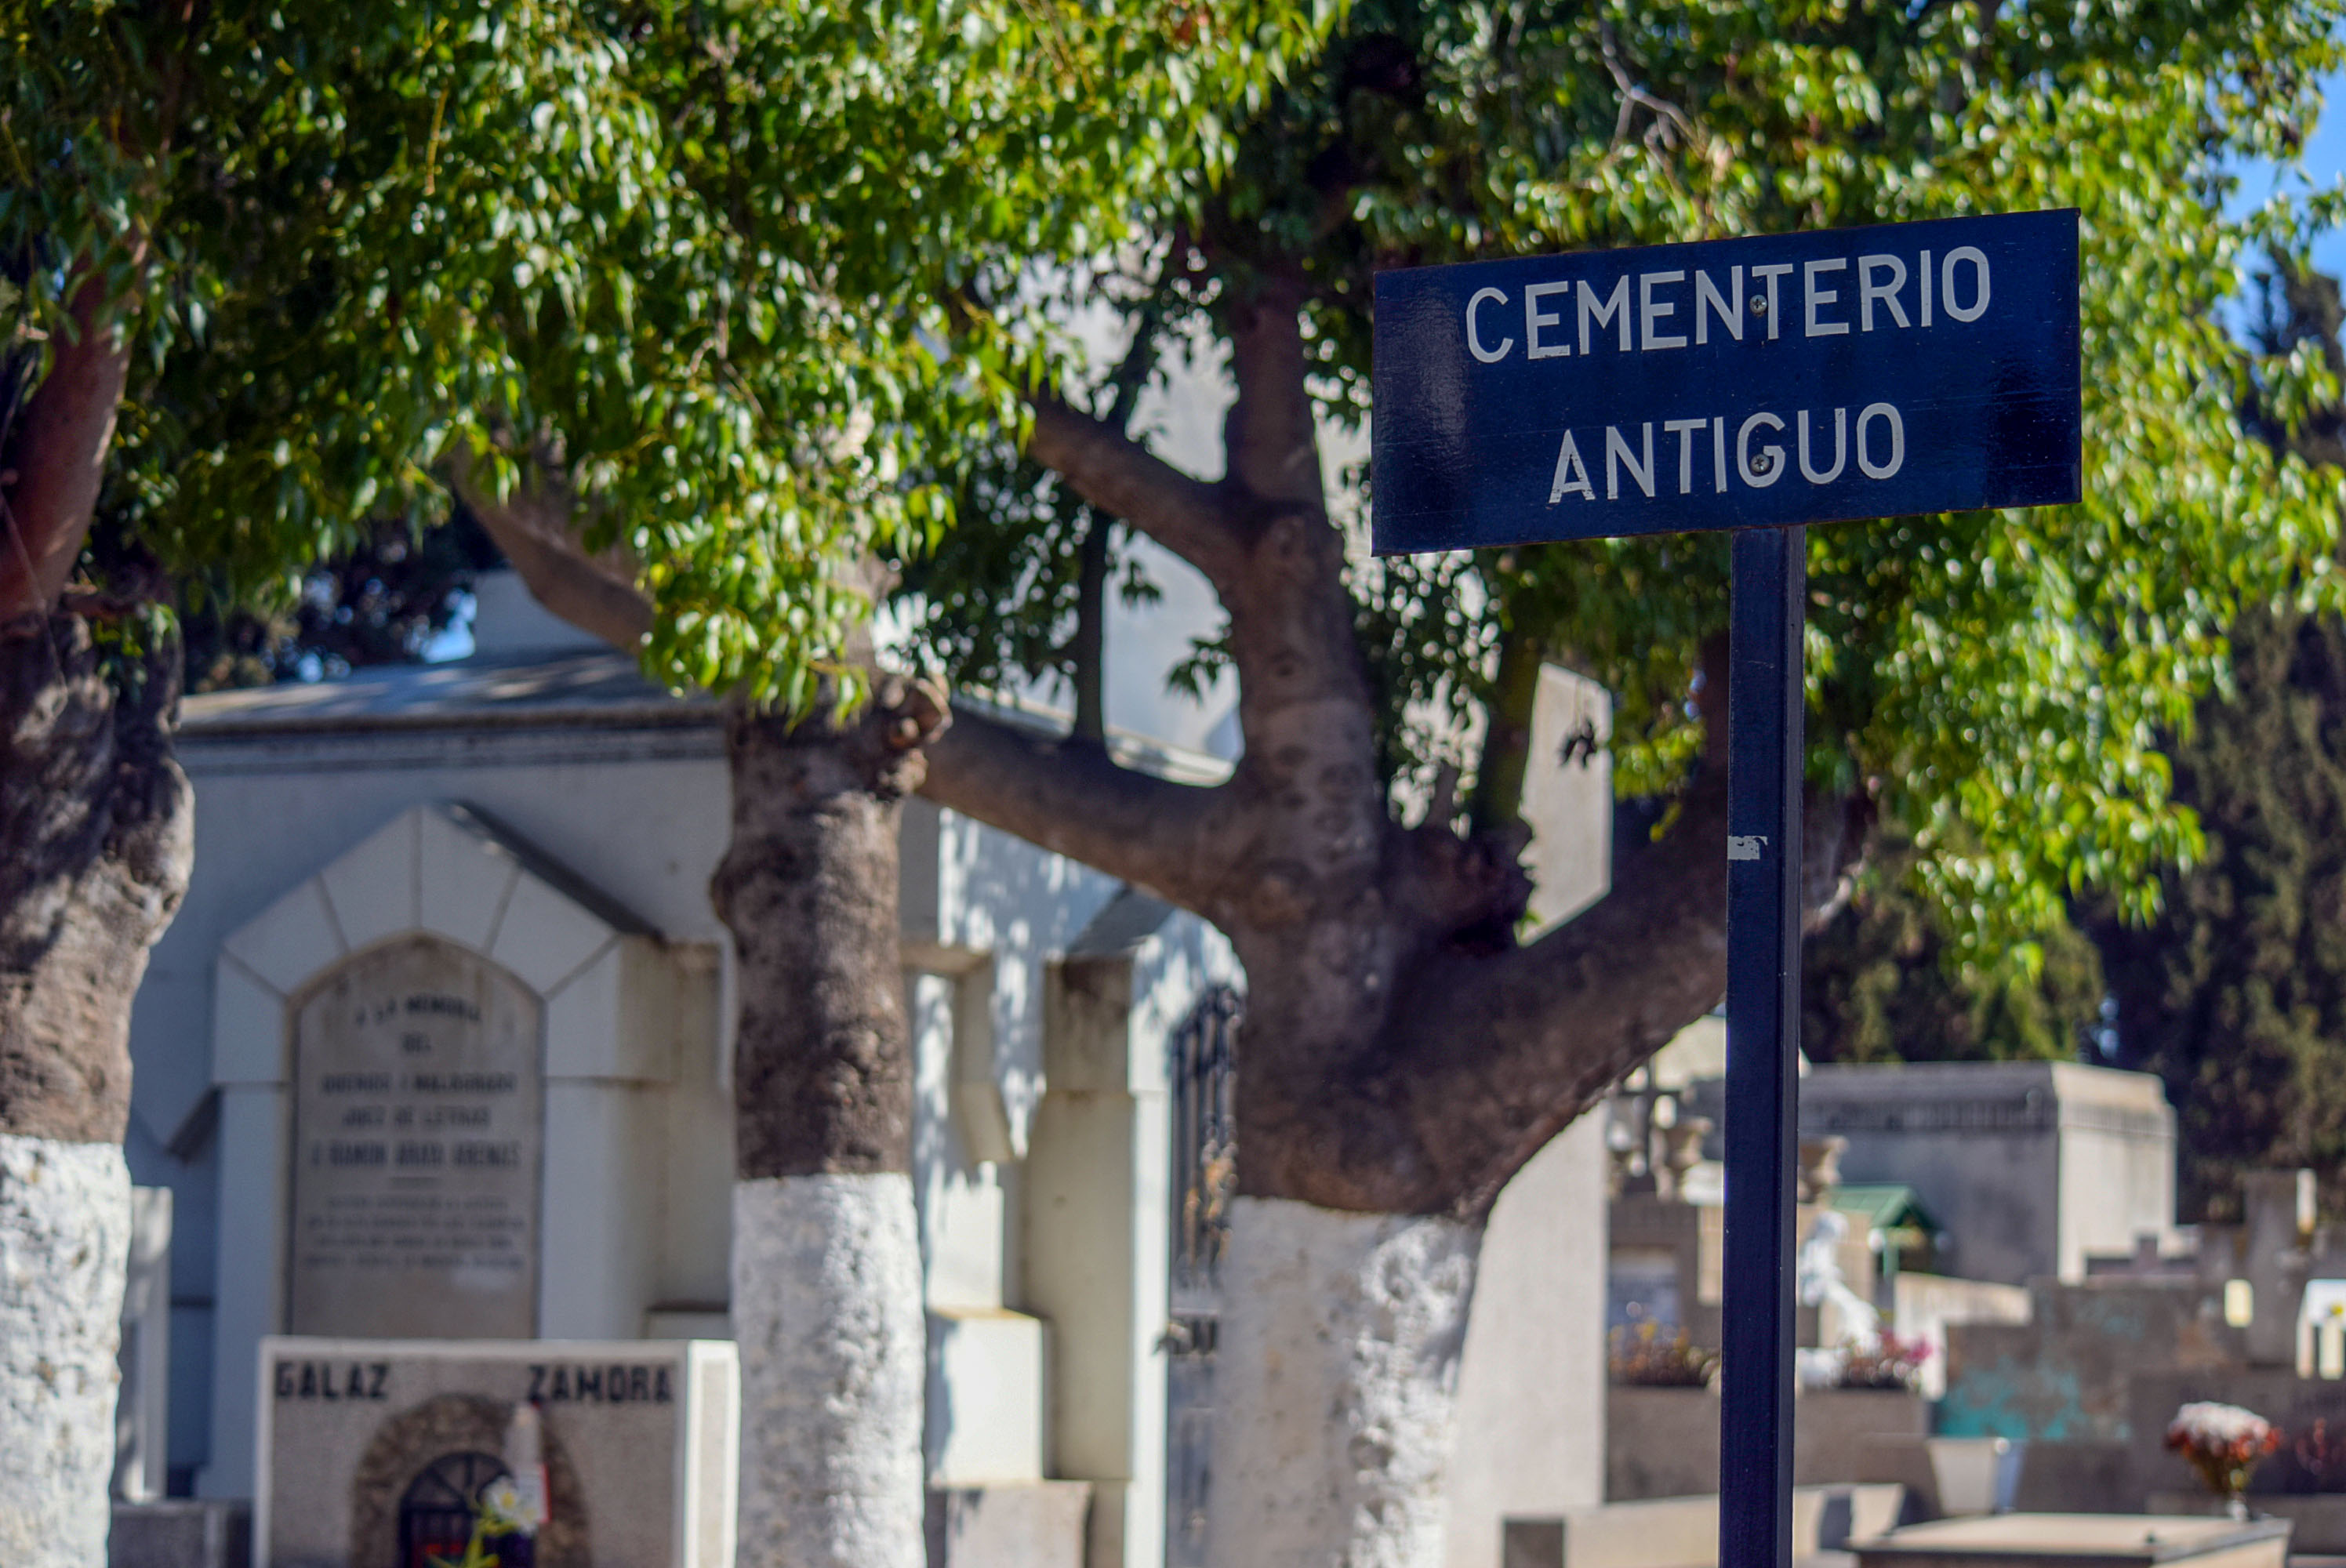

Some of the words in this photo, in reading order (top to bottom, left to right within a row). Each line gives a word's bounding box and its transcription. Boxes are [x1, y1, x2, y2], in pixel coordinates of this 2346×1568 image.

[1466, 246, 1990, 363] CEMENTERIO
[1549, 402, 1905, 503] ANTIGUO
[277, 1362, 390, 1399] GALAZ
[527, 1364, 673, 1403] ZAMORA
